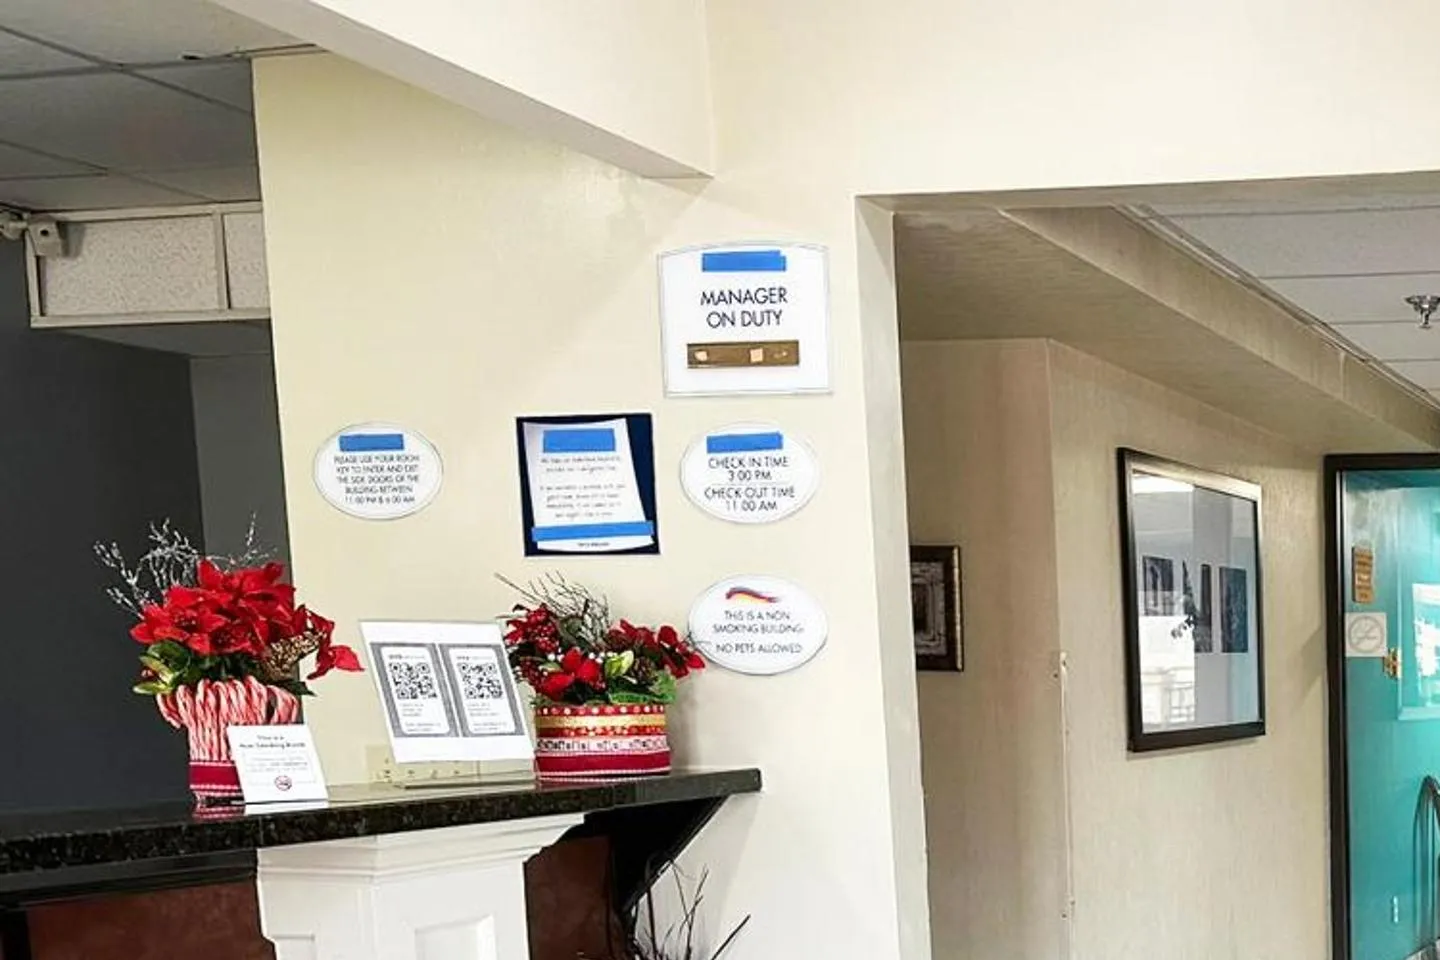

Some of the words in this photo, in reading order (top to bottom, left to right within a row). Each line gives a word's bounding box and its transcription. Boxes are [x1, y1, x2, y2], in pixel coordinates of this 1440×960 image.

[700, 287, 788, 306] MANAGER
[706, 311, 736, 329] ON
[741, 310, 783, 328] DUTY
[708, 457, 745, 469] CHECK
[748, 457, 761, 468] IN
[765, 456, 790, 468] TIME
[728, 470, 751, 481] 300
[755, 469, 772, 480] PM
[704, 487, 742, 500] CHECK
[745, 487, 768, 498] OUT
[772, 486, 796, 498] TIME
[726, 500, 757, 512] 1100
[758, 500, 778, 511] AM
[724, 610, 744, 621] THIS
[746, 610, 755, 620] IS
[766, 610, 791, 620] NON
[713, 623, 759, 633] SMOKING
[761, 622, 805, 634] BUILDING
[716, 643, 732, 653] NO
[735, 643, 755, 653] PETS
[758, 643, 802, 653] ALLOWED
